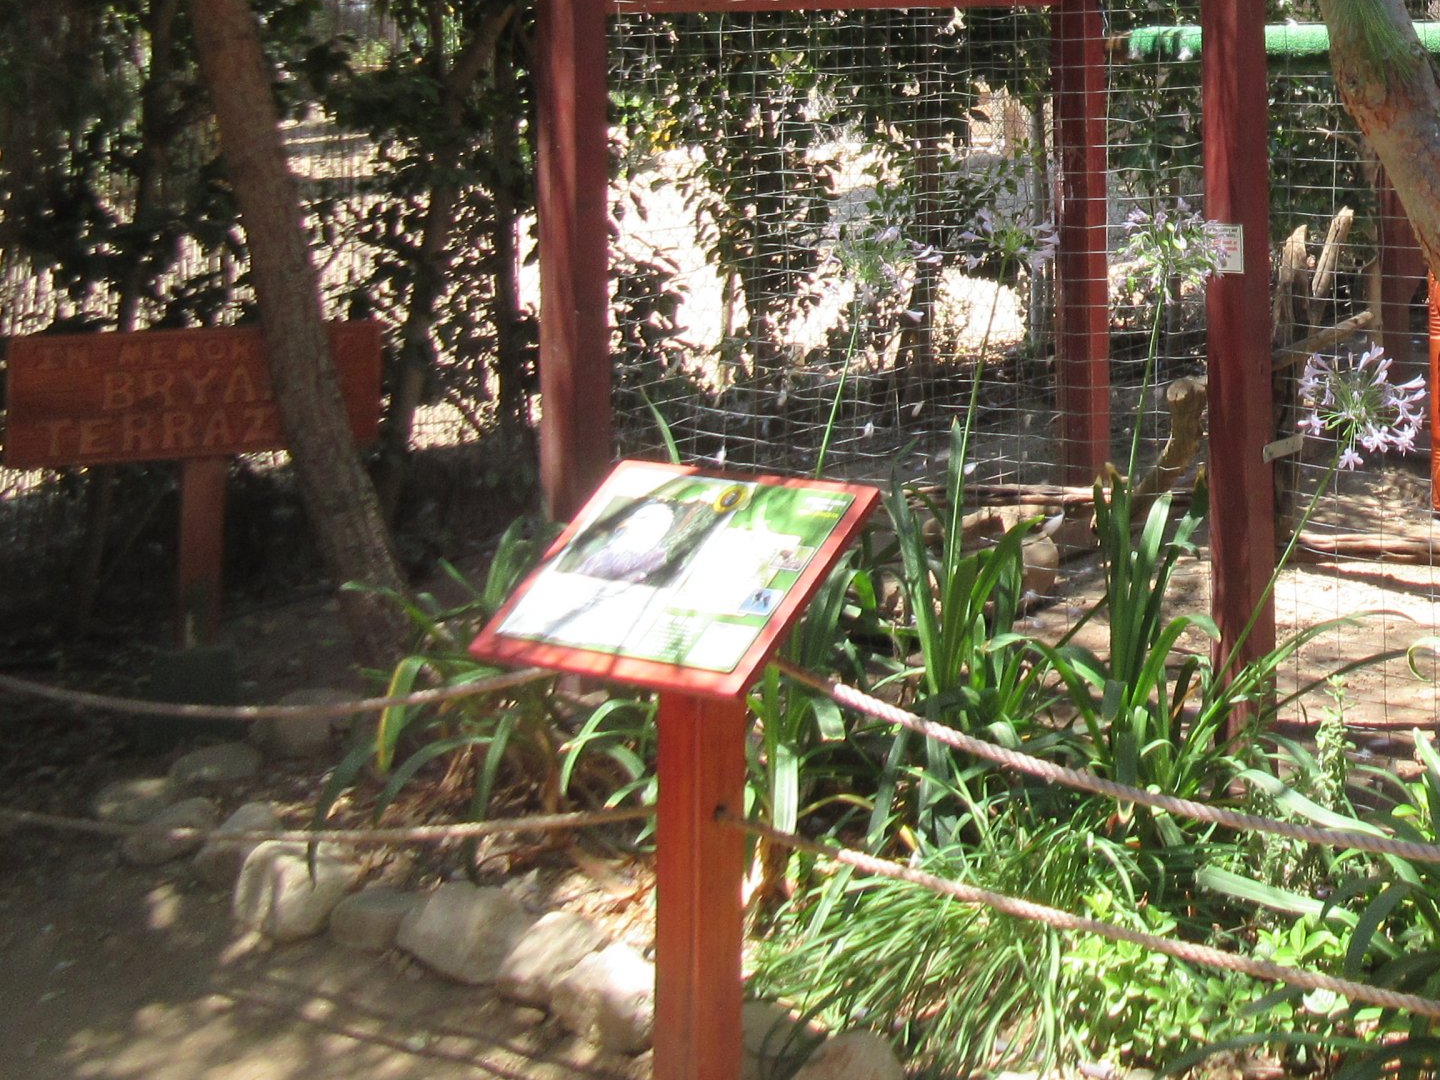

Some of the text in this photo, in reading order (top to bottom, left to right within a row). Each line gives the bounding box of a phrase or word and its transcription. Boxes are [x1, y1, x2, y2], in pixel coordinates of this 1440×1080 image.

[118, 338, 253, 367] MEMOR
[102, 364, 274, 411] BRYA
[39, 405, 279, 457] TERRAZ
